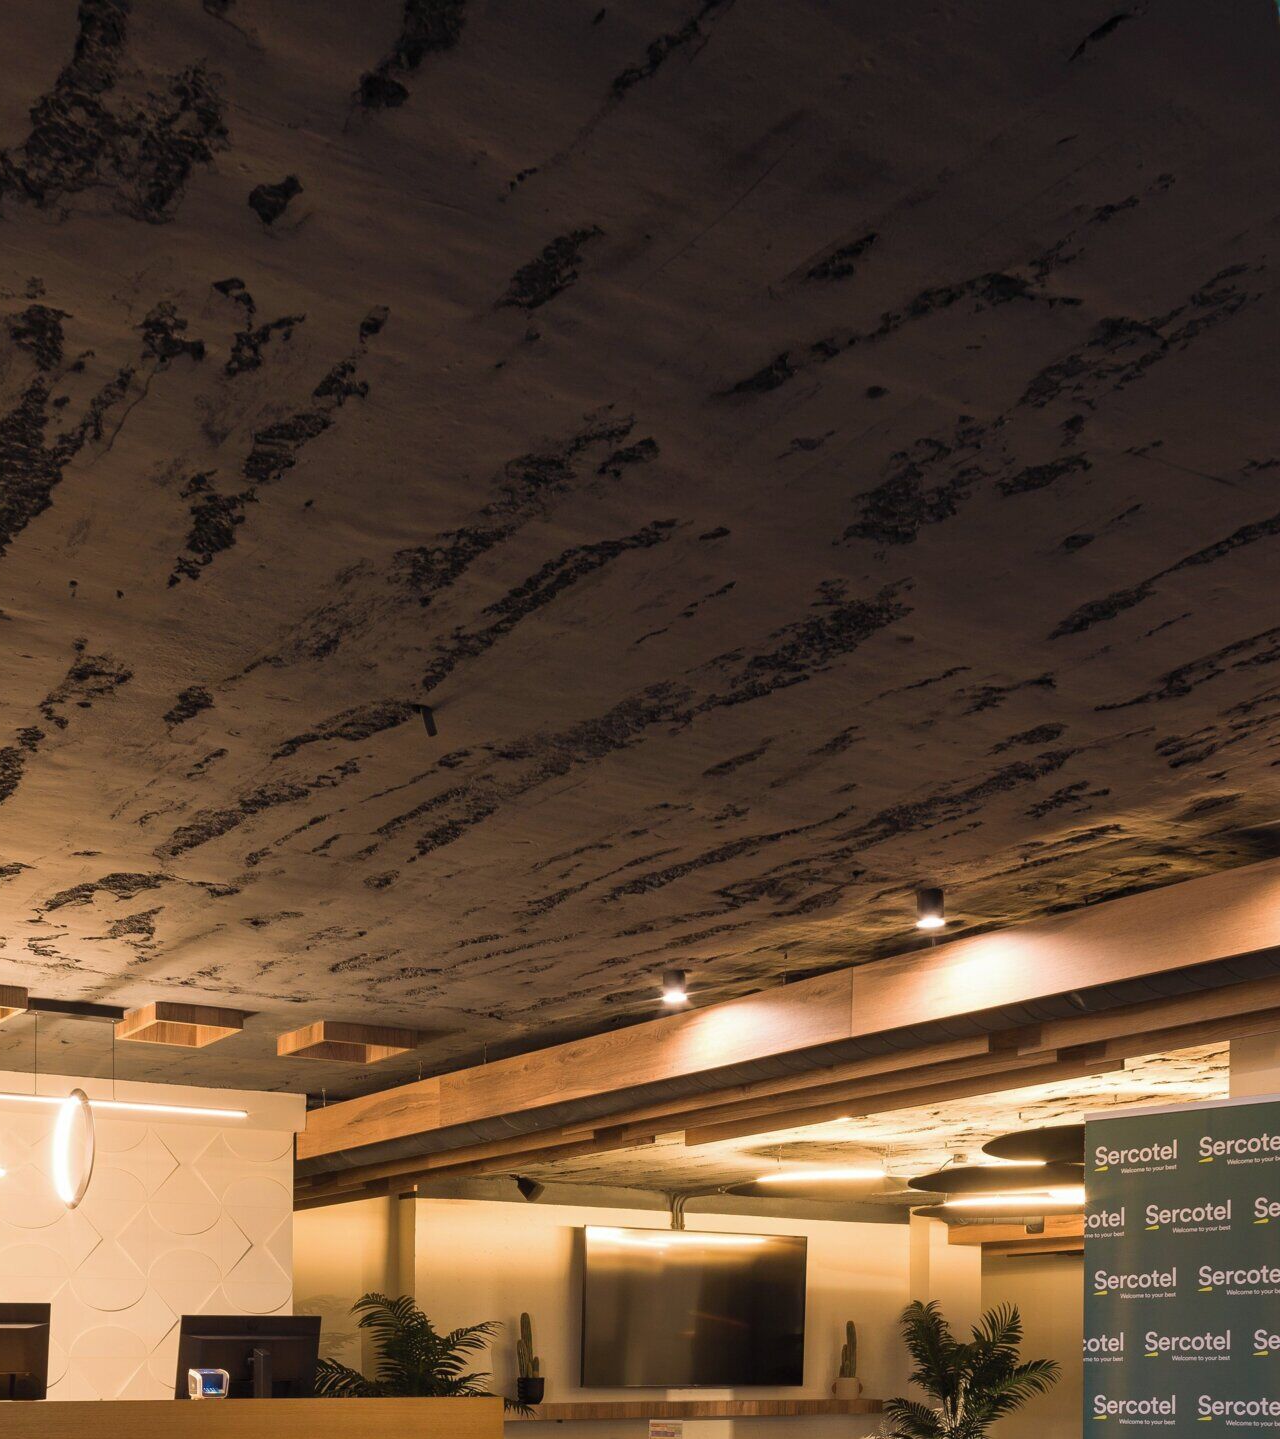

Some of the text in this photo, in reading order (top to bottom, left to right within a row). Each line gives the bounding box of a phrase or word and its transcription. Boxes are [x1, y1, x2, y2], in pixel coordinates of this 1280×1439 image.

[1095, 1139, 1177, 1166] Sercotel
[1146, 1199, 1231, 1225] Sercotel
[1094, 1267, 1177, 1290] Sercotel
[1144, 1329, 1231, 1351] Sercotel
[1093, 1394, 1176, 1415] Sercotel
